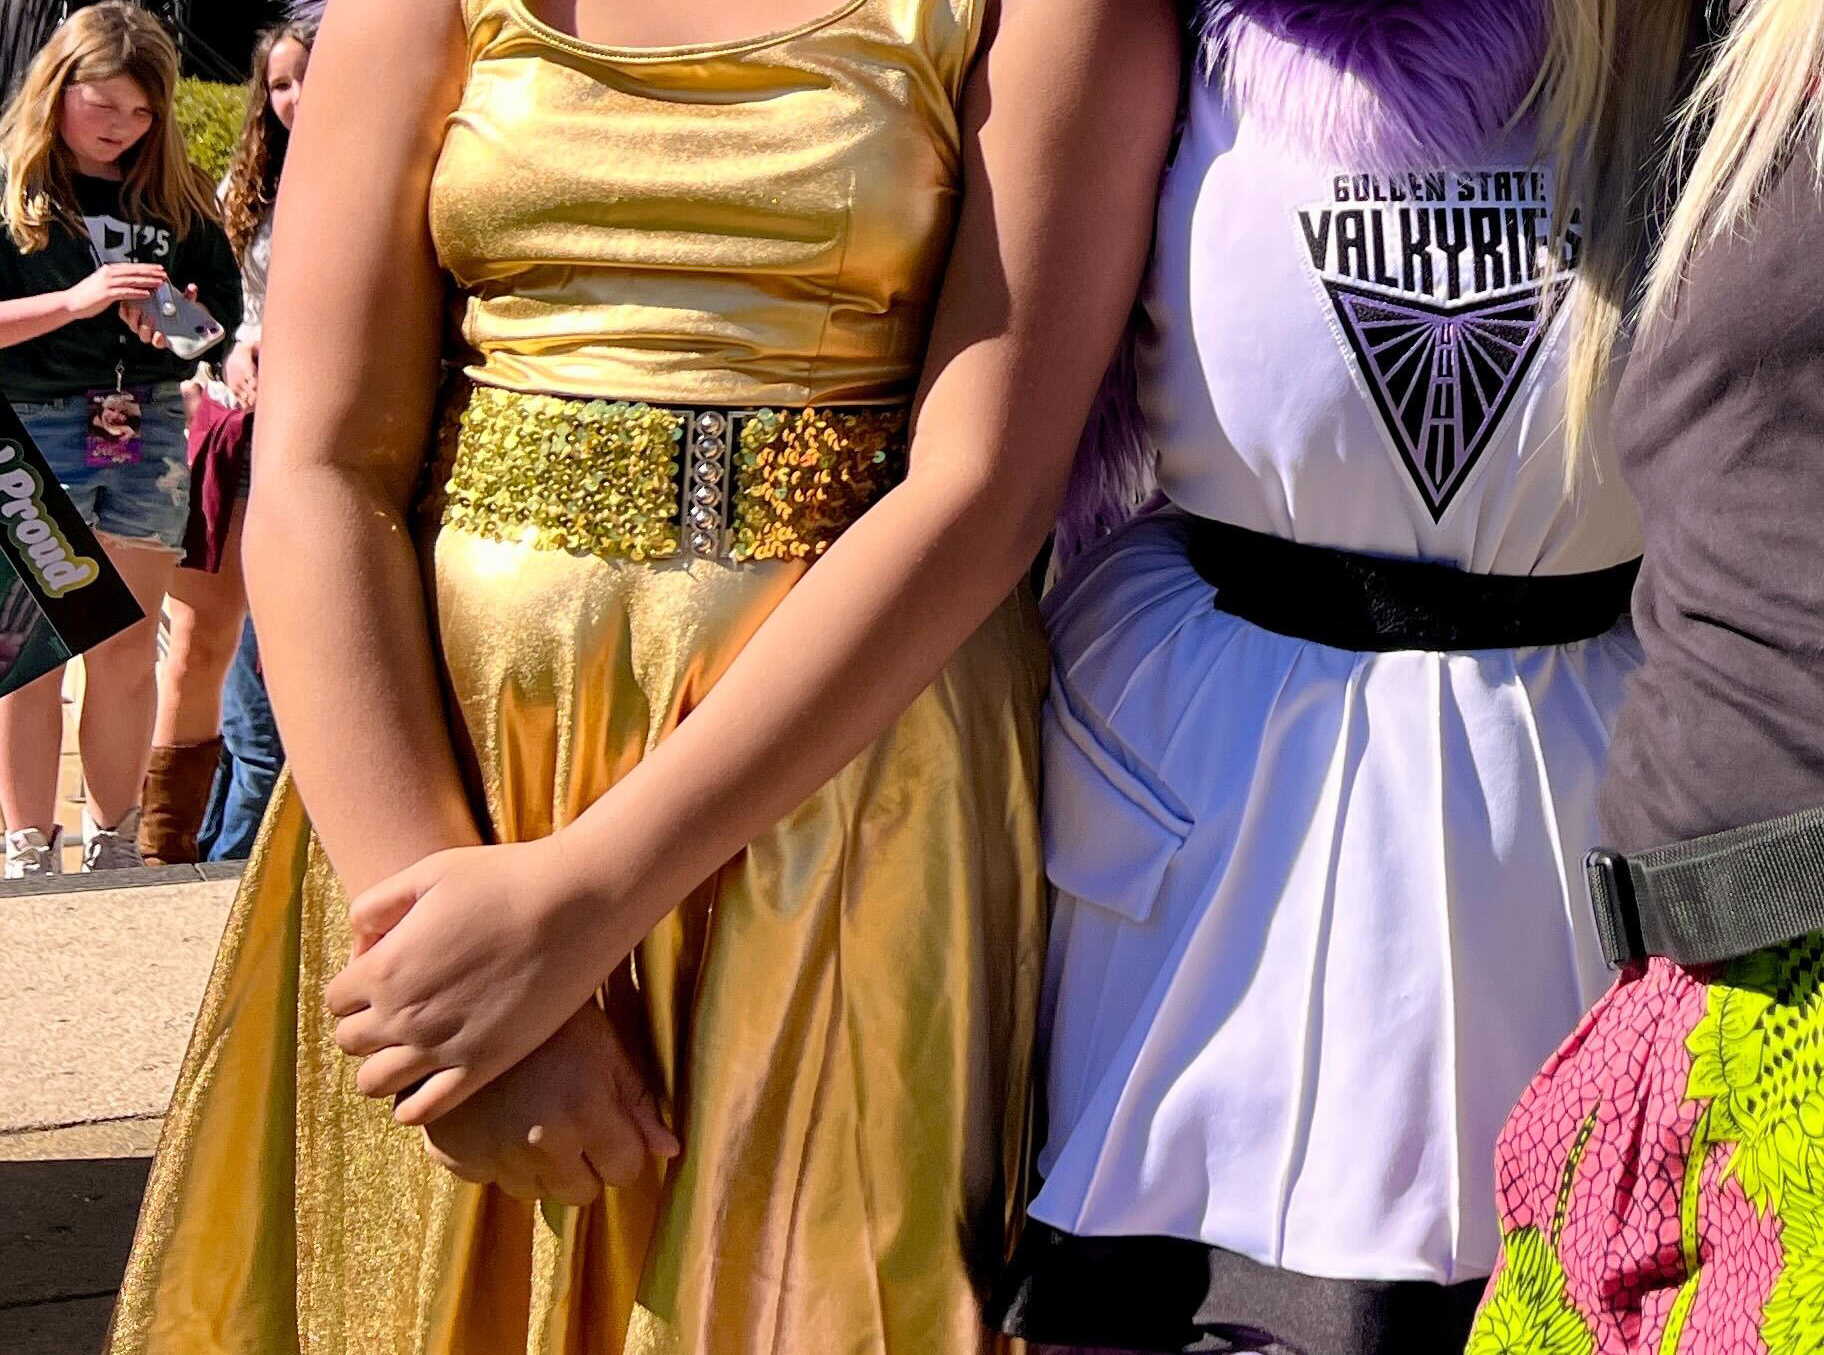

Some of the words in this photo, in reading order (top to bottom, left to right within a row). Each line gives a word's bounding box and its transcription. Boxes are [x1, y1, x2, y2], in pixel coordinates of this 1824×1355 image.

[1333, 172, 1446, 202] GOLDEN
[1457, 170, 1547, 202] STATE
[0, 467, 92, 591] Proud
